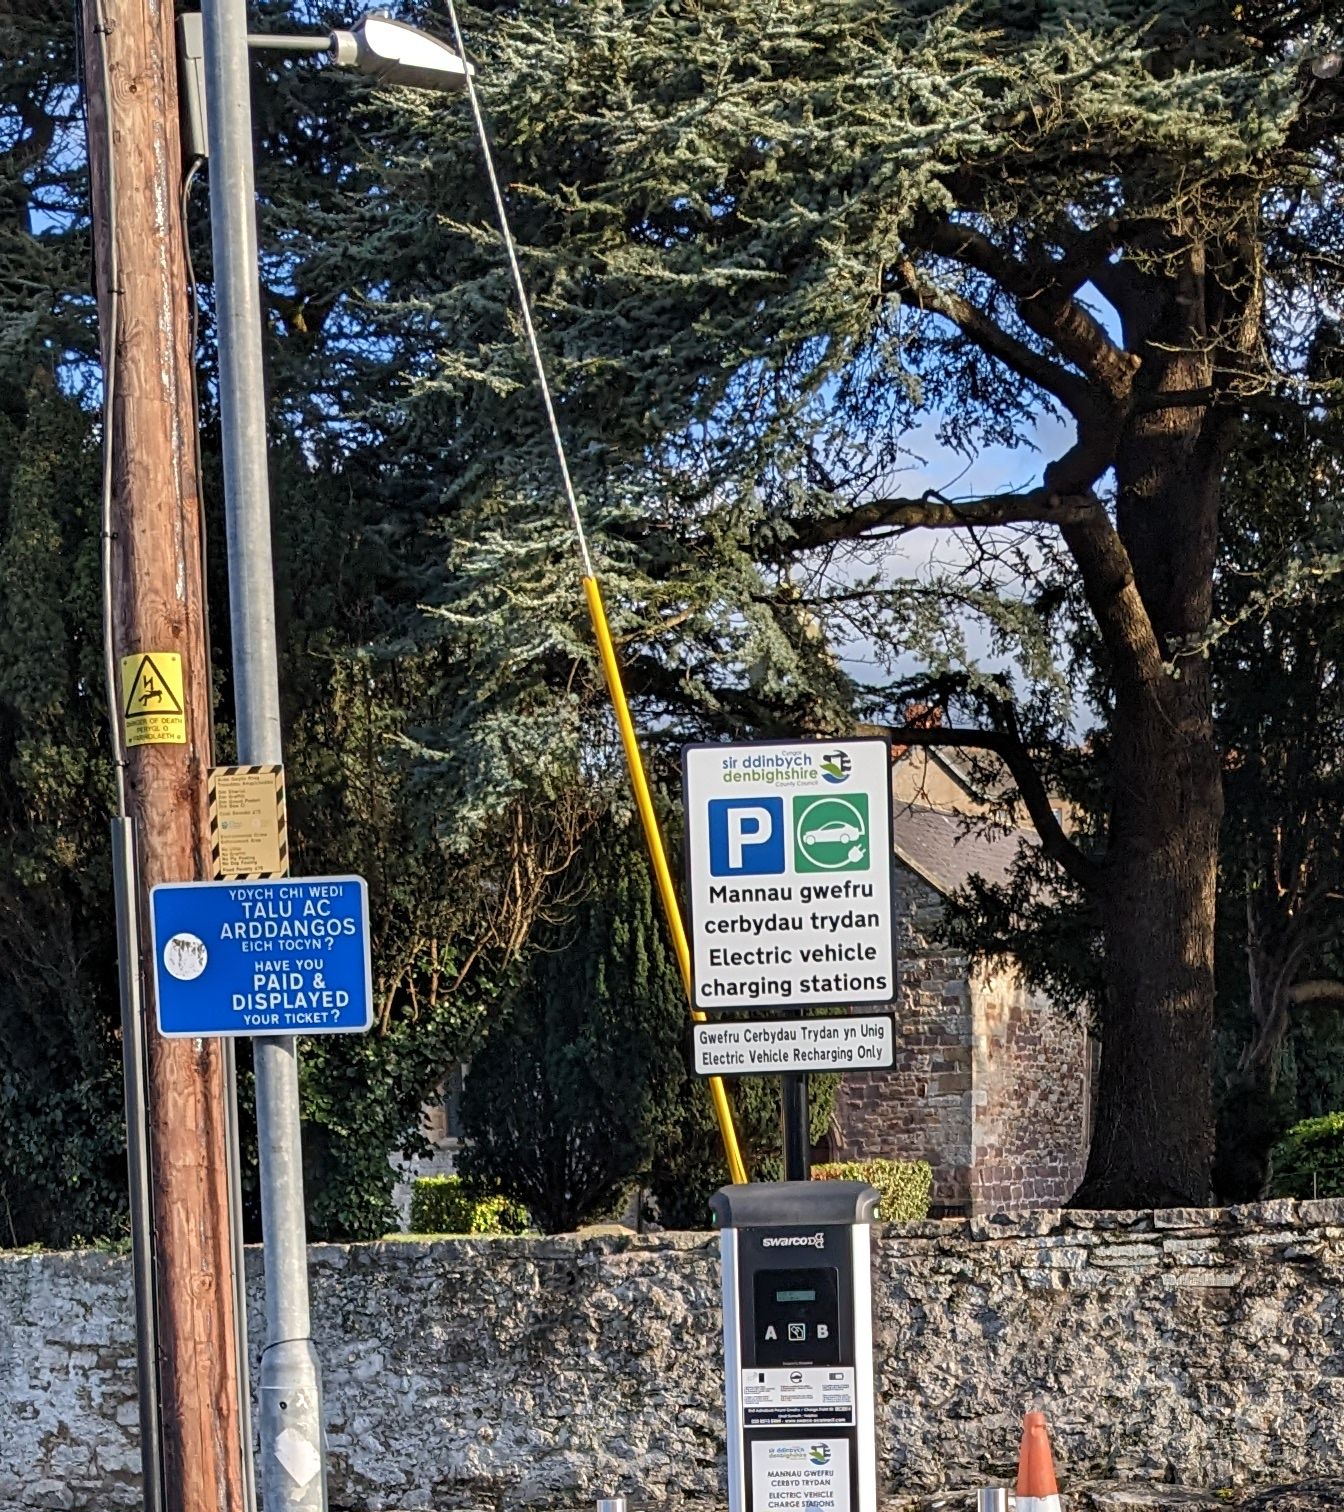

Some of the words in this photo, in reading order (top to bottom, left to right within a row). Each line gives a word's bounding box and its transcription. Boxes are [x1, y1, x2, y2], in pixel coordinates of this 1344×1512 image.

[722, 756, 737, 769] sir
[742, 753, 812, 769] ddinbych
[723, 767, 818, 784] denbighshire
[727, 806, 773, 869] P
[229, 888, 274, 901] YDYCH
[279, 887, 303, 899] CHI
[308, 886, 343, 898] WEDI
[709, 885, 793, 904] Mannau
[799, 880, 874, 904] gwefru
[241, 900, 293, 919] TALU
[303, 899, 331, 917] AC
[220, 918, 356, 940] ARDDANGOS
[704, 914, 803, 936] cerbydau
[810, 910, 880, 933] trydan
[242, 940, 273, 952] EICH
[709, 946, 793, 966] Electric
[799, 942, 877, 963] vehicle
[254, 960, 290, 972] HAVE
[295, 958, 324, 970] YOU
[254, 972, 304, 991] PAID
[312, 972, 326, 989] &
[701, 976, 792, 999] charging
[799, 973, 887, 993] stations
[232, 990, 349, 1011] DISPLAYED
[243, 1014, 279, 1025] YOUR
[699, 1030, 739, 1045] Gwefru
[743, 1028, 797, 1044] Cerbydau
[801, 1026, 839, 1042] Trydan
[843, 1027, 857, 1041] yn
[861, 1024, 884, 1040] Unig
[702, 1050, 745, 1066] Electric
[748, 1048, 789, 1064] Vehicle
[793, 1046, 853, 1063] Recharging
[857, 1045, 883, 1061] Only
[762, 1237, 808, 1247] swarco
[764, 1325, 778, 1340] A
[816, 1324, 829, 1339] B
[801, 1500, 835, 1508] STATIONS
